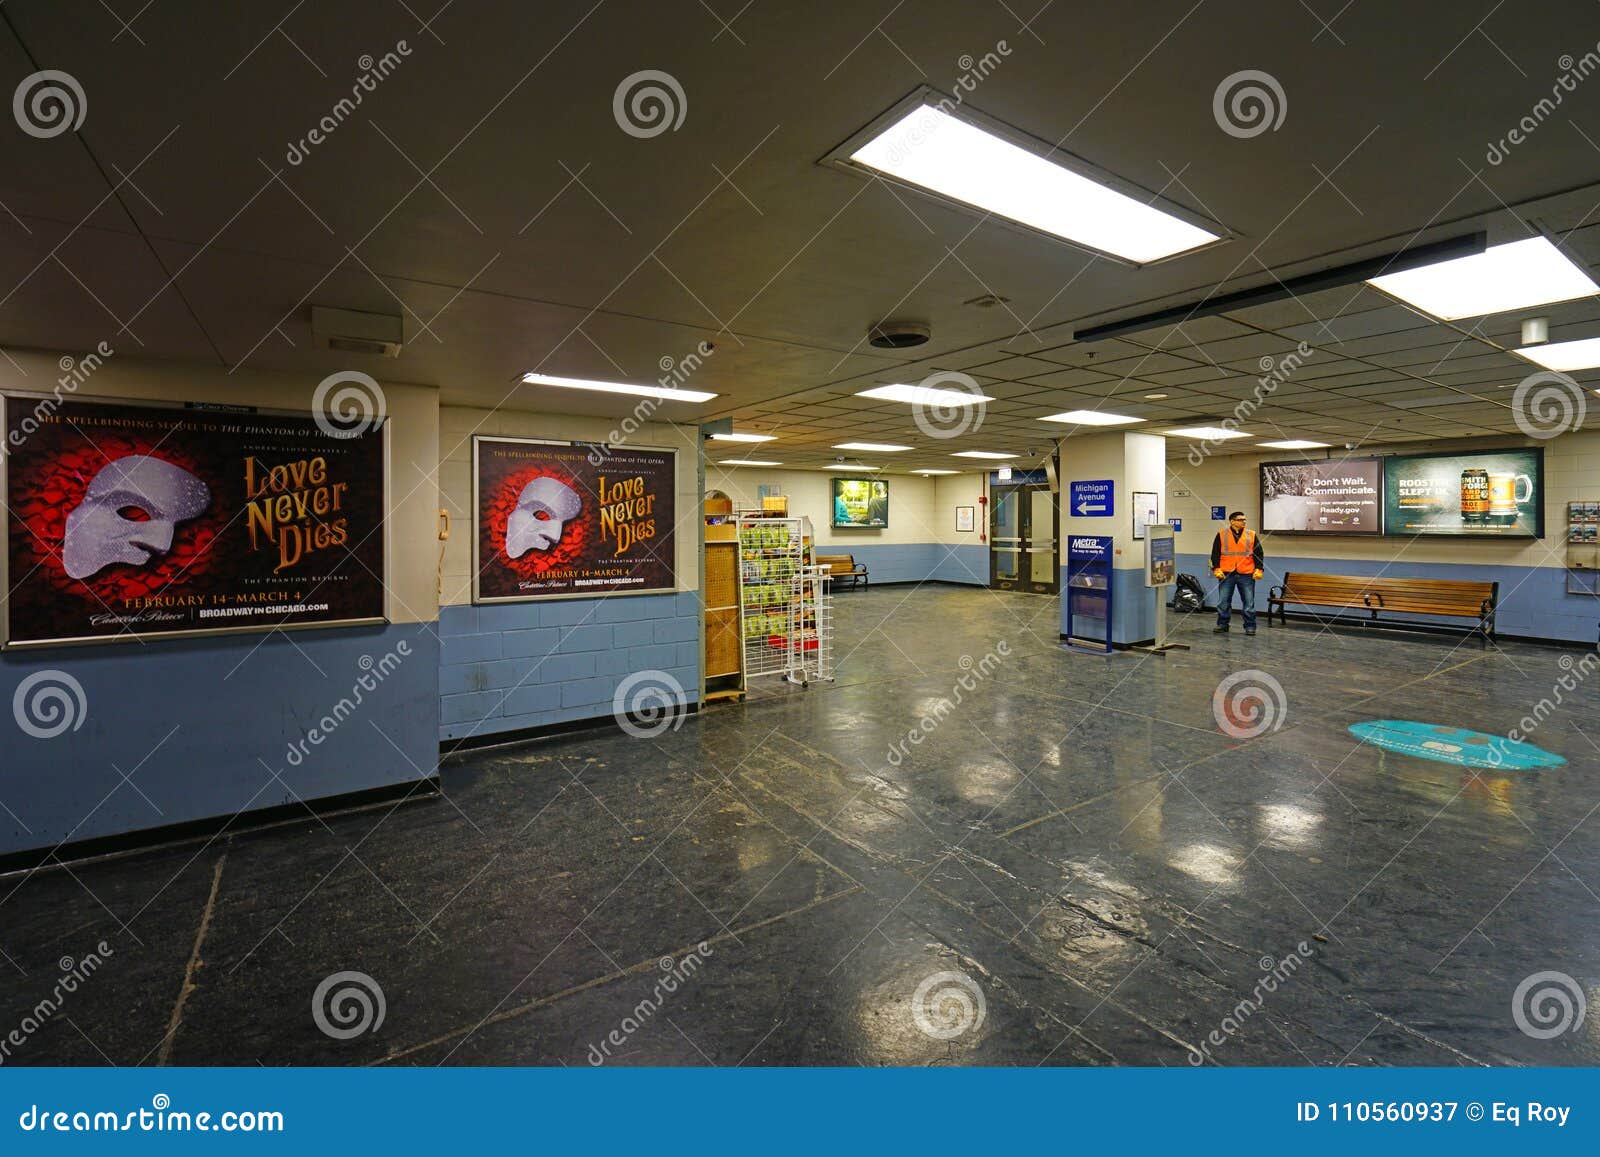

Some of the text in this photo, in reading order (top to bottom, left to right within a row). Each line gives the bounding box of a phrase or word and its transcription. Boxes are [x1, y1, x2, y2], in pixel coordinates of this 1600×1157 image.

[66, 416, 153, 429] SPELLBINDING
[158, 420, 198, 431] SEQUEL
[203, 423, 217, 432] TO
[222, 424, 241, 433] THE
[245, 426, 295, 436] PHANTOM
[298, 428, 311, 437] OF
[243, 456, 327, 499] Love
[1313, 476, 1367, 487] Don't Wait.
[598, 476, 644, 506] Love
[1075, 484, 1109, 493] Michigan
[1304, 486, 1377, 496] Communicate.
[1399, 488, 1432, 496] SLEPT
[1078, 493, 1106, 501] Avenue
[246, 481, 349, 551] Never
[1319, 506, 1360, 514] Ready.gov
[598, 494, 656, 544] Never
[614, 518, 656, 558] Dies
[1071, 538, 1098, 549] Metra
[273, 518, 348, 575] Dies
[536, 569, 579, 580] FEBRUARY
[624, 568, 630, 577] 4
[125, 594, 207, 609] FEBRUARY
[293, 591, 301, 601] 4
